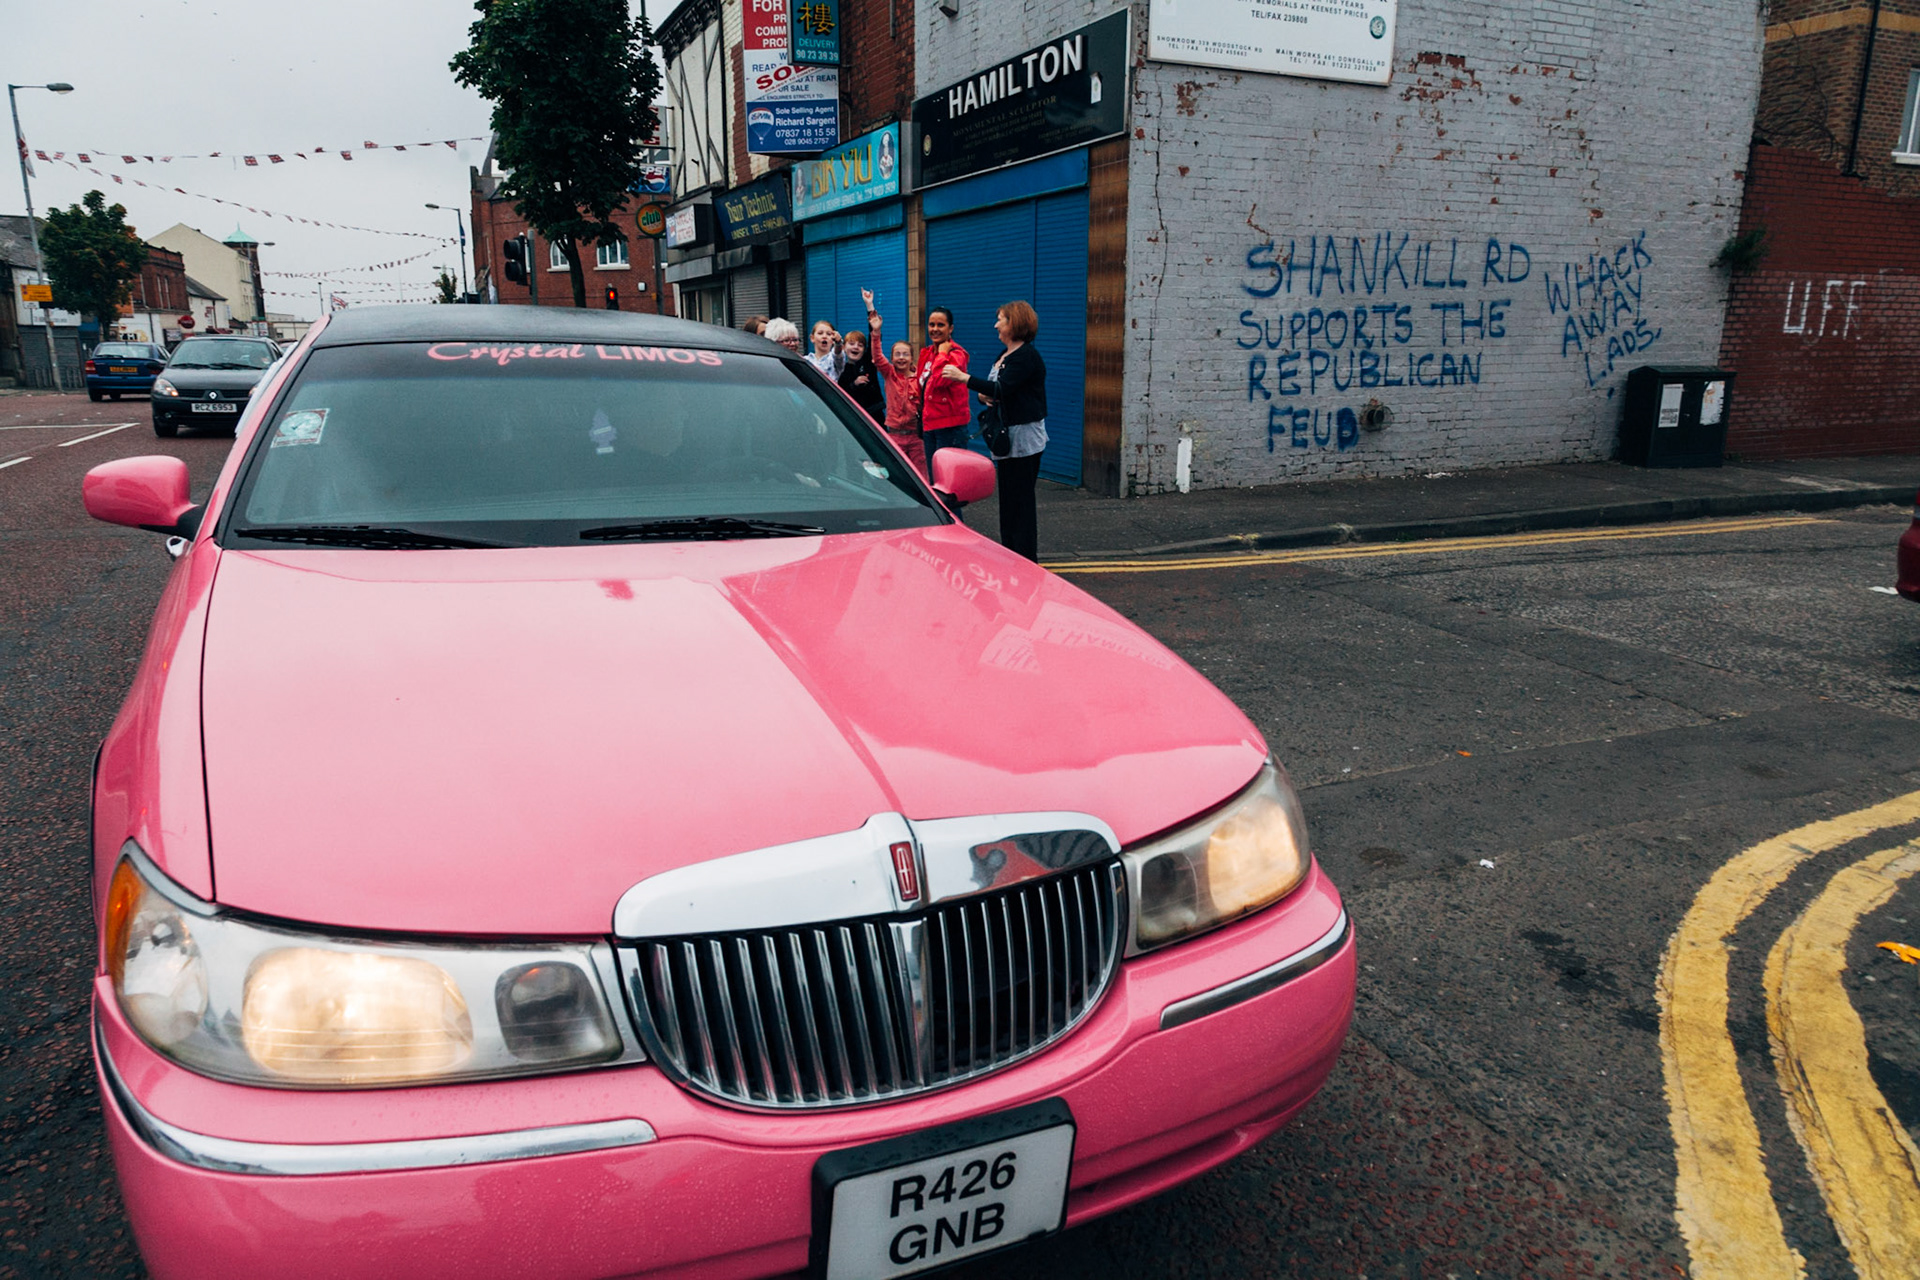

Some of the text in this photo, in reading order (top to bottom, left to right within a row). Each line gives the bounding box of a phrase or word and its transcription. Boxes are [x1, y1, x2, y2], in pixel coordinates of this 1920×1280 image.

[753, 0, 782, 13] FOR
[1251, 10, 1281, 21] TEL/FAX
[1311, 4, 1342, 15] KEENEST
[1344, 9, 1369, 19] PRICES
[1341, 0, 1364, 9] YEARS
[797, 1, 836, 33] 樓
[799, 37, 836, 49] DELIVERY
[1297, 51, 1320, 59] WORKS
[807, 50, 817, 60] 23
[829, 51, 839, 61] 39
[756, 65, 809, 90] SOL
[790, 84, 809, 92] SALE
[949, 34, 1083, 119] HAMILTON
[775, 107, 790, 115] Sole
[815, 106, 834, 115] Agent
[775, 116, 836, 127] Richard Sargent
[775, 127, 836, 138] 07837 18 15 58
[1240, 230, 1531, 298] SHANKILL RD
[1544, 230, 1653, 315] WHACK
[1237, 300, 1511, 349] SUPPORTS THE
[1562, 273, 1642, 358] AWAY
[427, 342, 723, 366] Crystal LIMOS
[1248, 350, 1484, 403] REPUBLICAN
[1267, 404, 1360, 454] FEUD
[889, 1151, 1017, 1219] R426
[888, 1202, 1005, 1266] GNB
